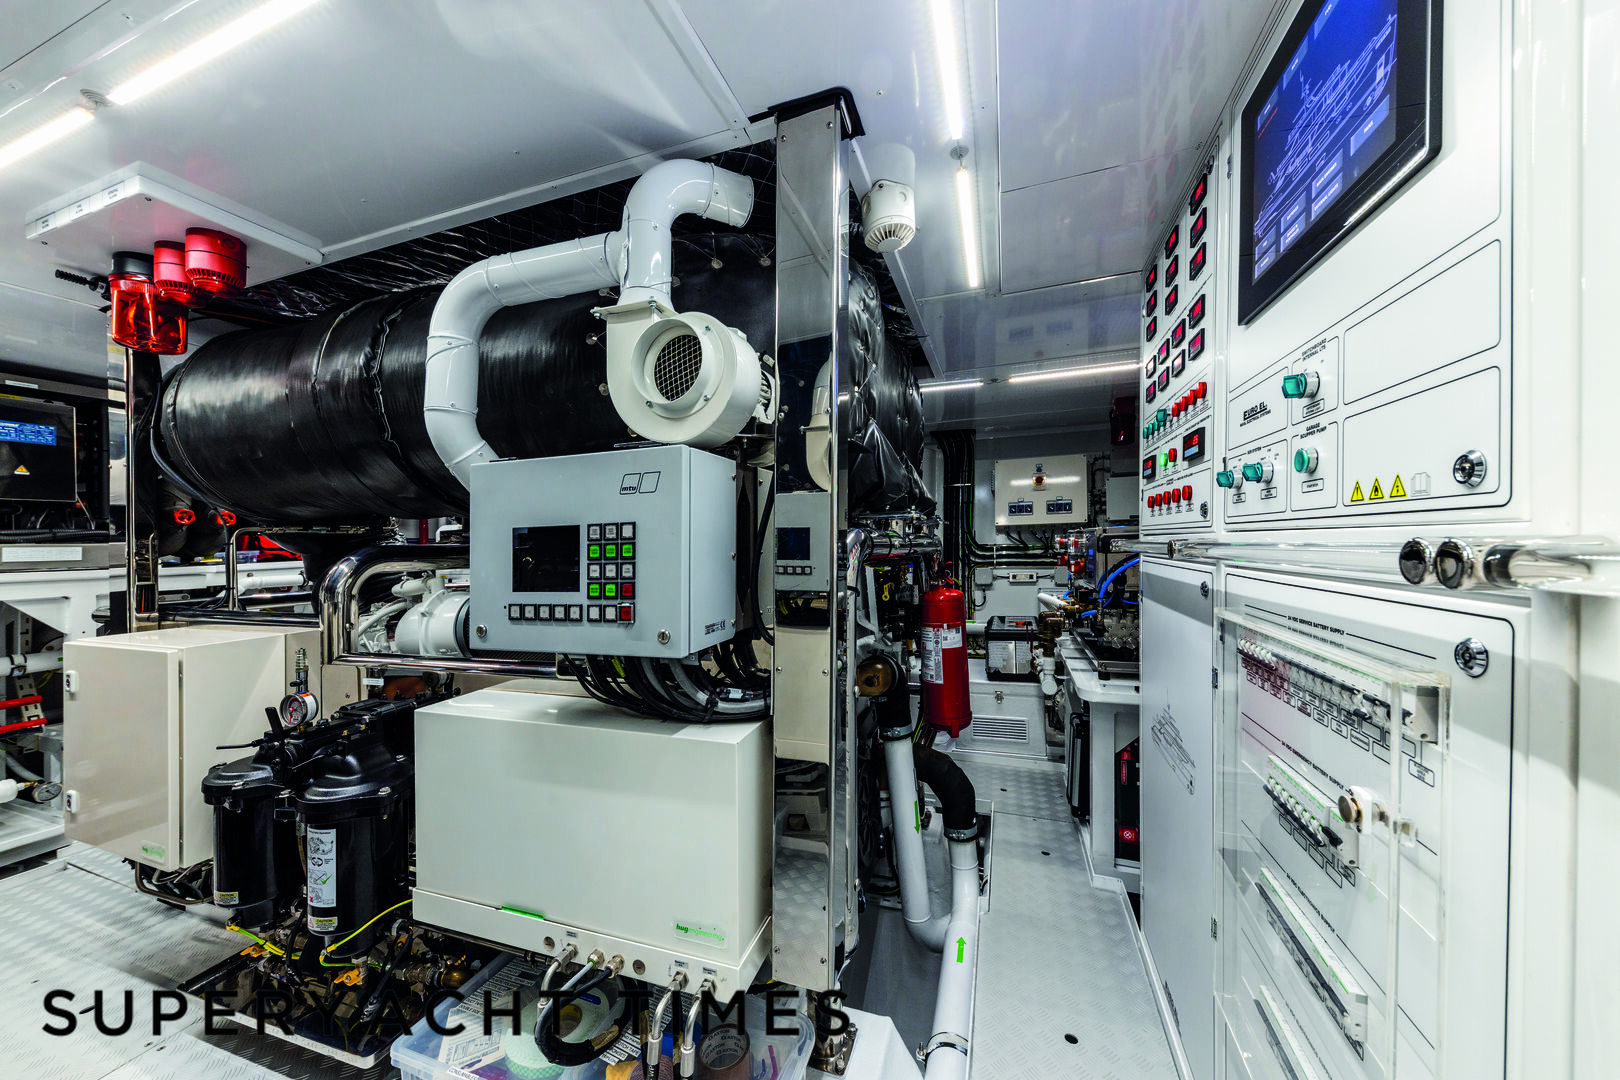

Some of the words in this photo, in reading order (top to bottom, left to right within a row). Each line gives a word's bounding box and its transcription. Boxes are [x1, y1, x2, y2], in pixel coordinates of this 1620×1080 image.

[1302, 338, 1327, 356] SWITCHBOARD
[1243, 405, 1258, 419] EURO
[1300, 430, 1316, 440] SCUPPER
[1316, 426, 1327, 435] PUMP
[1306, 422, 1320, 432] GARAGE
[1298, 618, 1313, 627] SERVICE
[1313, 622, 1329, 632] BATTERY
[1329, 626, 1345, 636] SUPPLY
[1312, 762, 1329, 778] BATTERY
[1328, 775, 1344, 790] SUPPLY
[713, 1029, 730, 1037] AXTON
